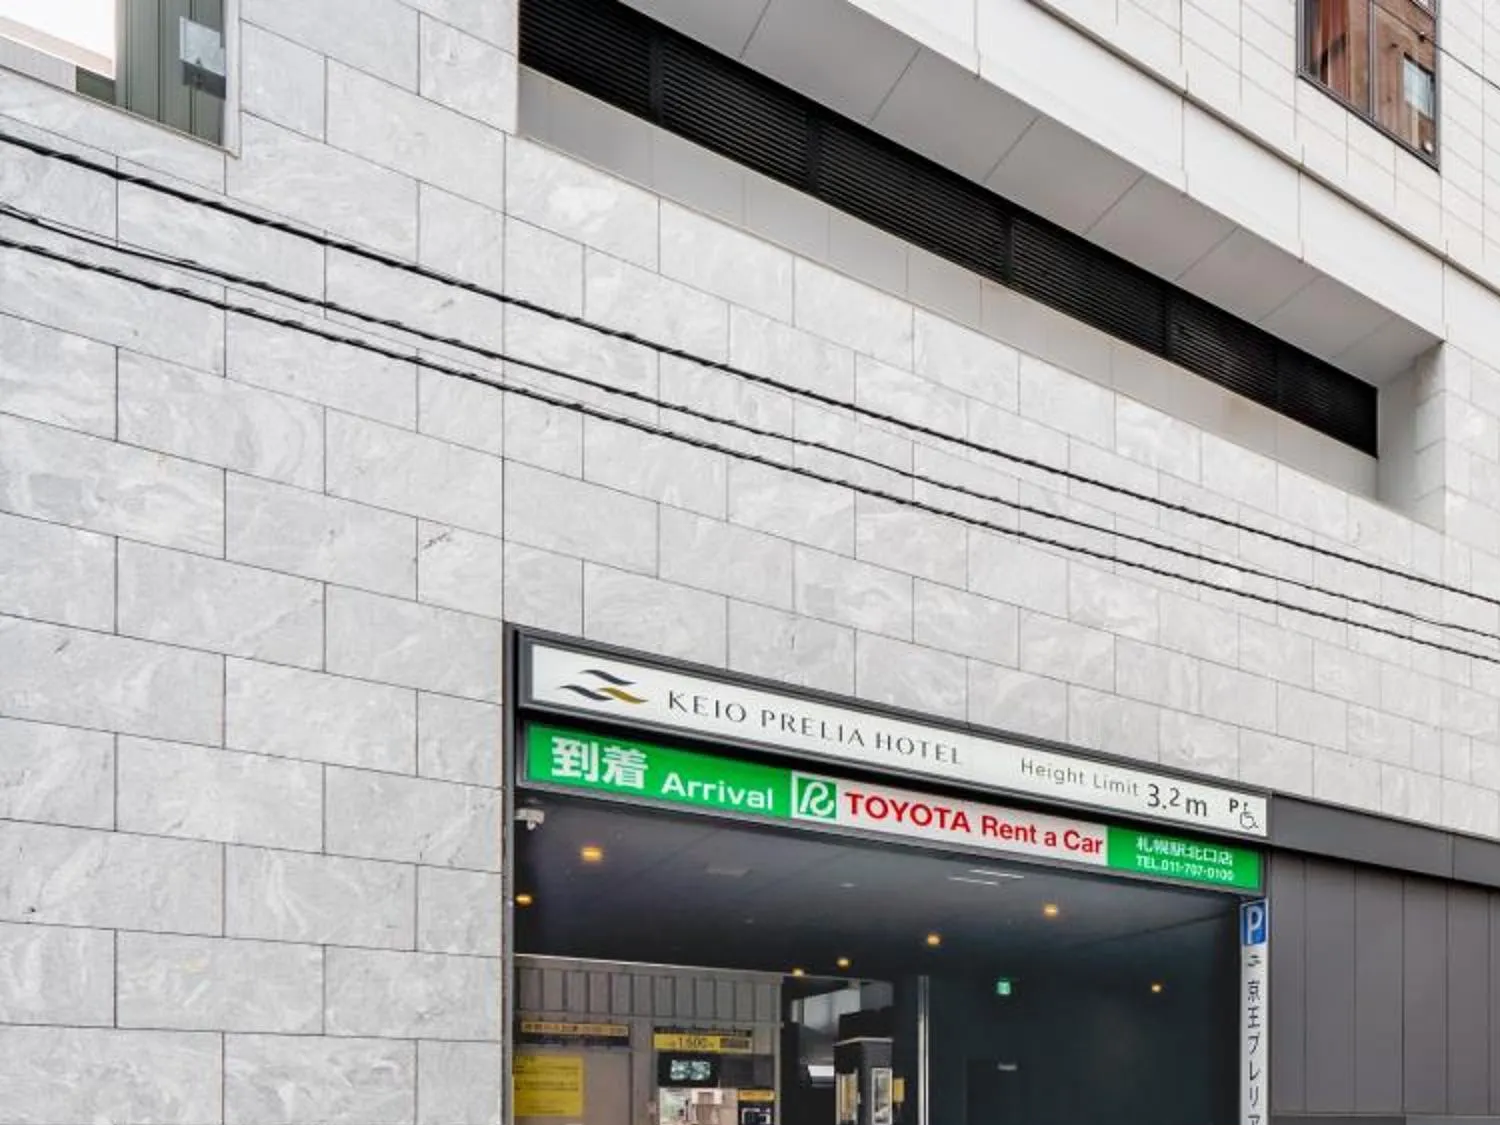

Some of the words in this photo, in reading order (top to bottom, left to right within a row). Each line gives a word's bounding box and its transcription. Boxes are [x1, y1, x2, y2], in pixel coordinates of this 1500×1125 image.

[668, 690, 747, 724] KEIO
[760, 708, 865, 748] PRELIA
[875, 731, 961, 765] HOTEL
[551, 736, 648, 789] 到着
[1020, 757, 1084, 787] Height
[1093, 774, 1139, 797] Limit
[661, 772, 774, 811] Arrival
[844, 791, 970, 833] TOYOTA
[981, 815, 1036, 844] Rent
[1043, 829, 1057, 847] a
[1063, 829, 1104, 854] Car
[1247, 905, 1263, 945] P
